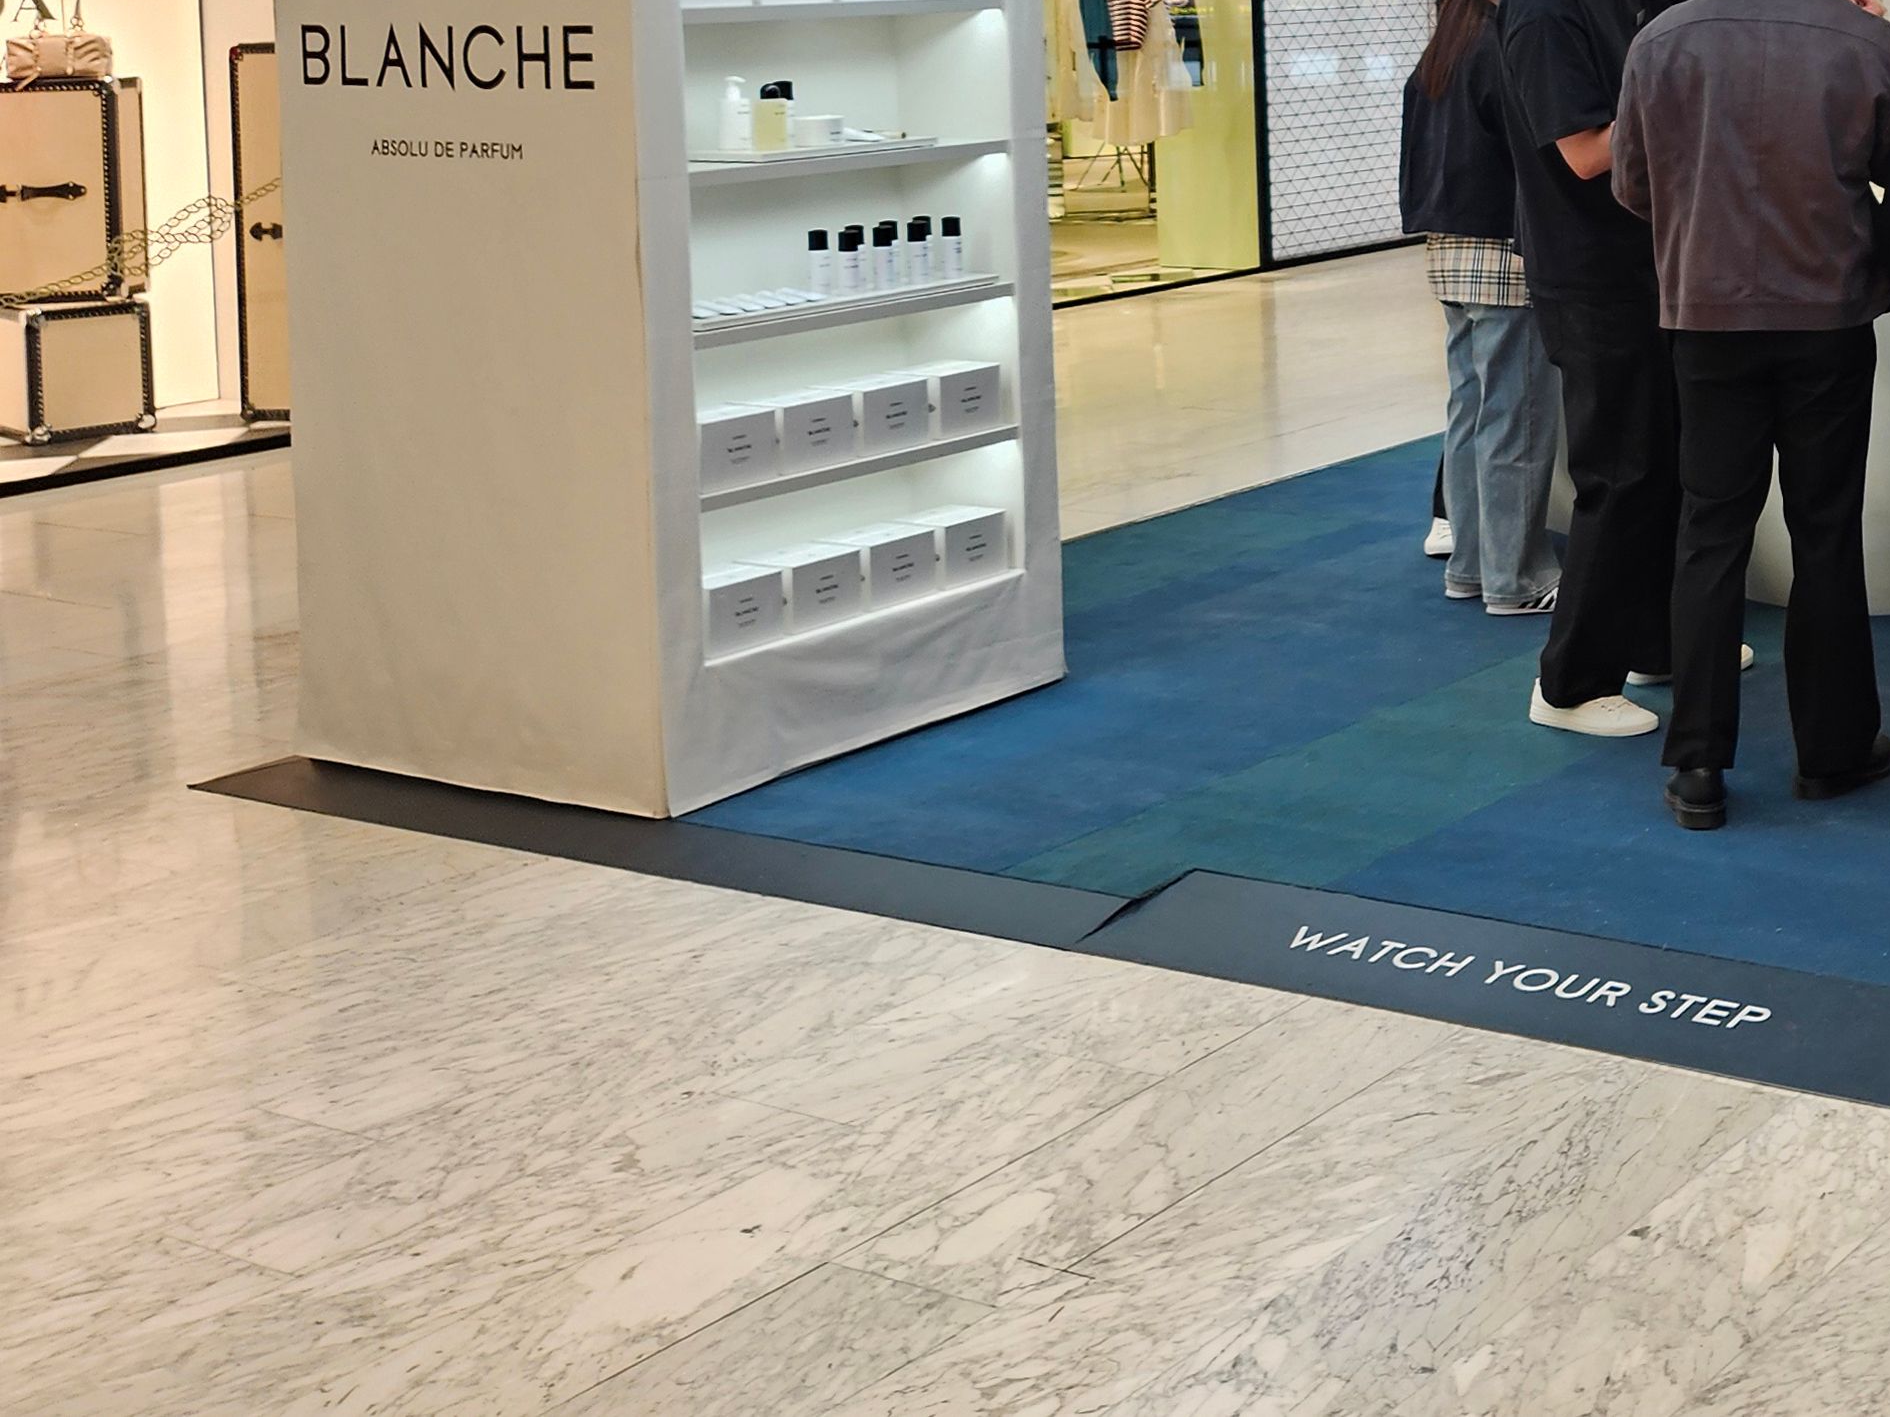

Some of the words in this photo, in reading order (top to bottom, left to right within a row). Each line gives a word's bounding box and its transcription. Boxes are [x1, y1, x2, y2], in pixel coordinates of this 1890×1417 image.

[300, 22, 596, 91] BLANCHE
[371, 138, 428, 158] ABSOLU
[434, 141, 455, 159] DE
[459, 141, 524, 160] PARFUM
[1289, 925, 1476, 978] WATCH
[1484, 960, 1632, 1007] YOUR
[1638, 989, 1773, 1030] STEP
